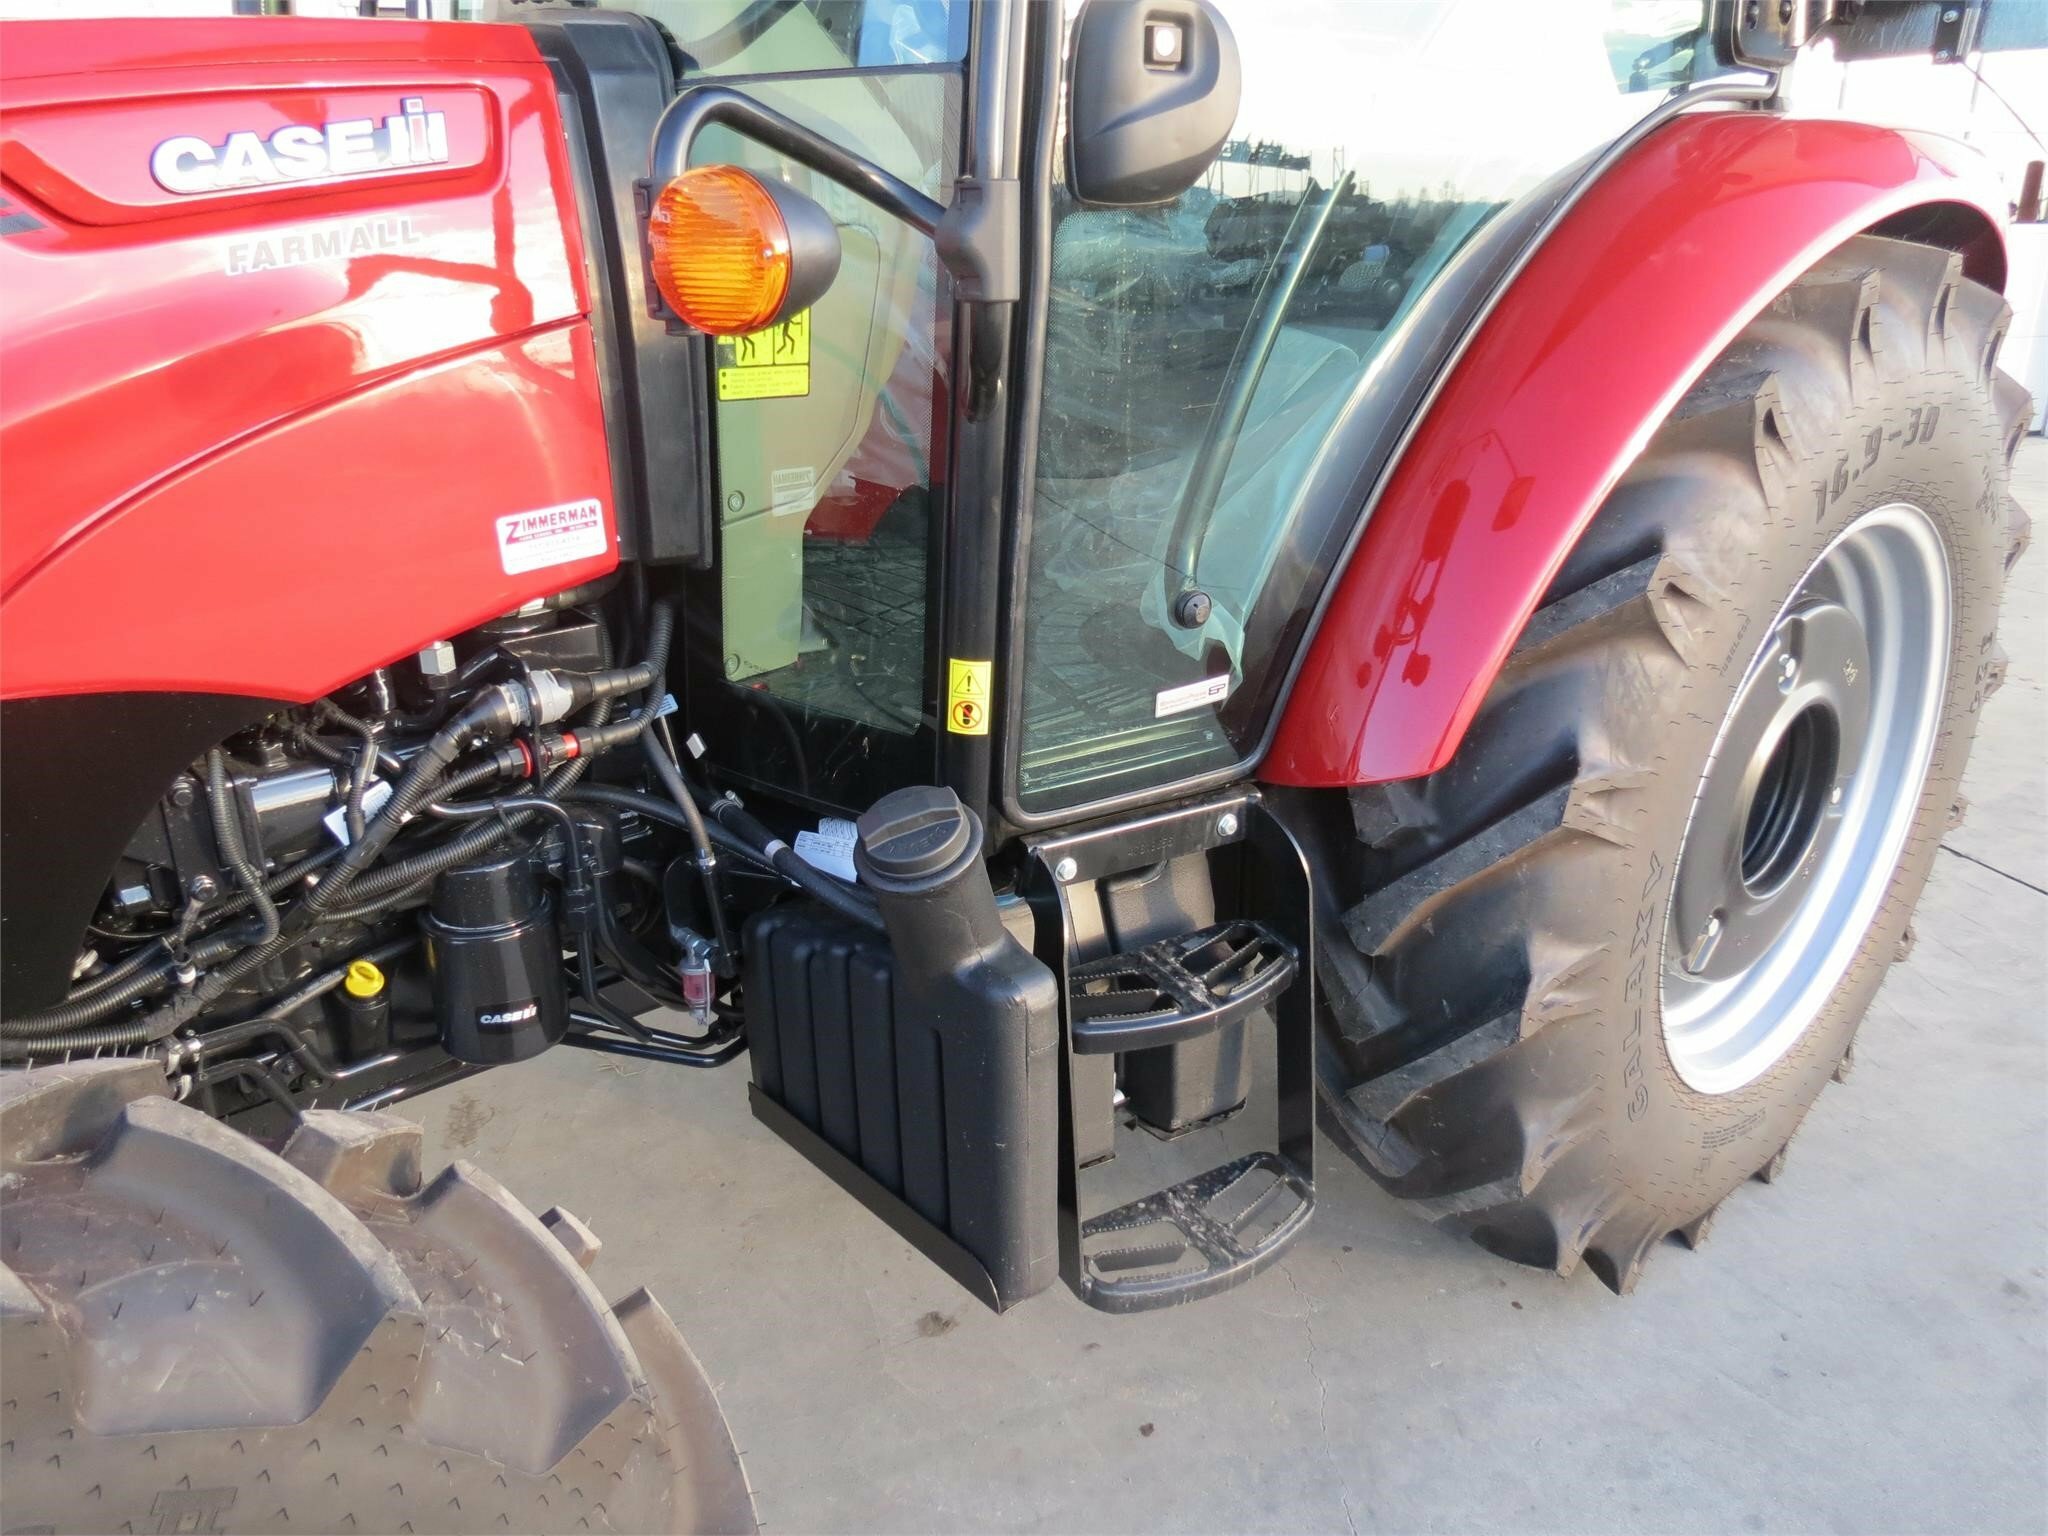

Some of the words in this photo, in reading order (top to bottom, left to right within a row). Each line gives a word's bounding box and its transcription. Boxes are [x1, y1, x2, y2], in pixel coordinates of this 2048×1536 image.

[147, 117, 378, 194] CASE
[227, 217, 420, 274] FARMALL
[1815, 405, 1941, 515] 16.9-30
[505, 504, 597, 545] ZIMMERMAN
[480, 1010, 524, 1024] CASE
[1622, 850, 1665, 1124] GALAXY
